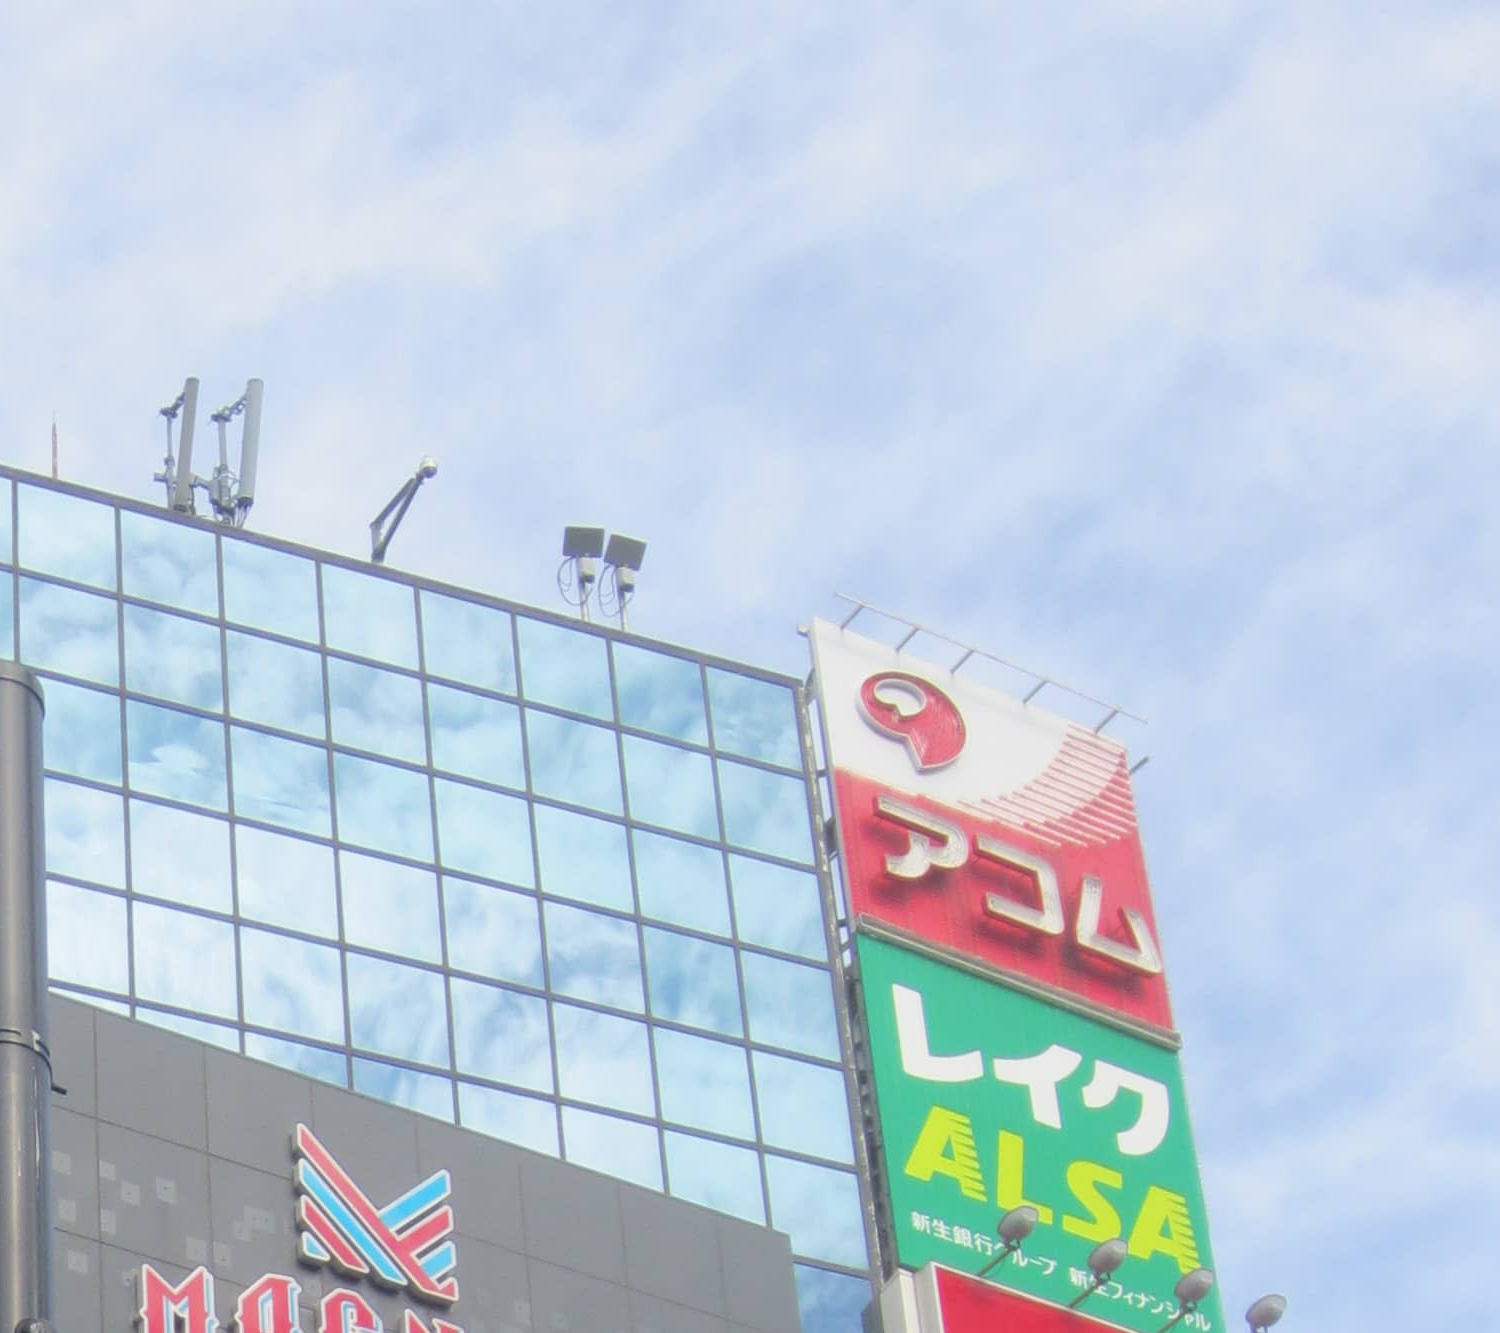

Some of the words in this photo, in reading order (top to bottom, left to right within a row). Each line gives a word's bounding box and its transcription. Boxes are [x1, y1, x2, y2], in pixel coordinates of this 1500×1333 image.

[874, 794, 1163, 976] アコム
[891, 982, 1171, 1157] レイク
[904, 1104, 1202, 1275] ALSA
